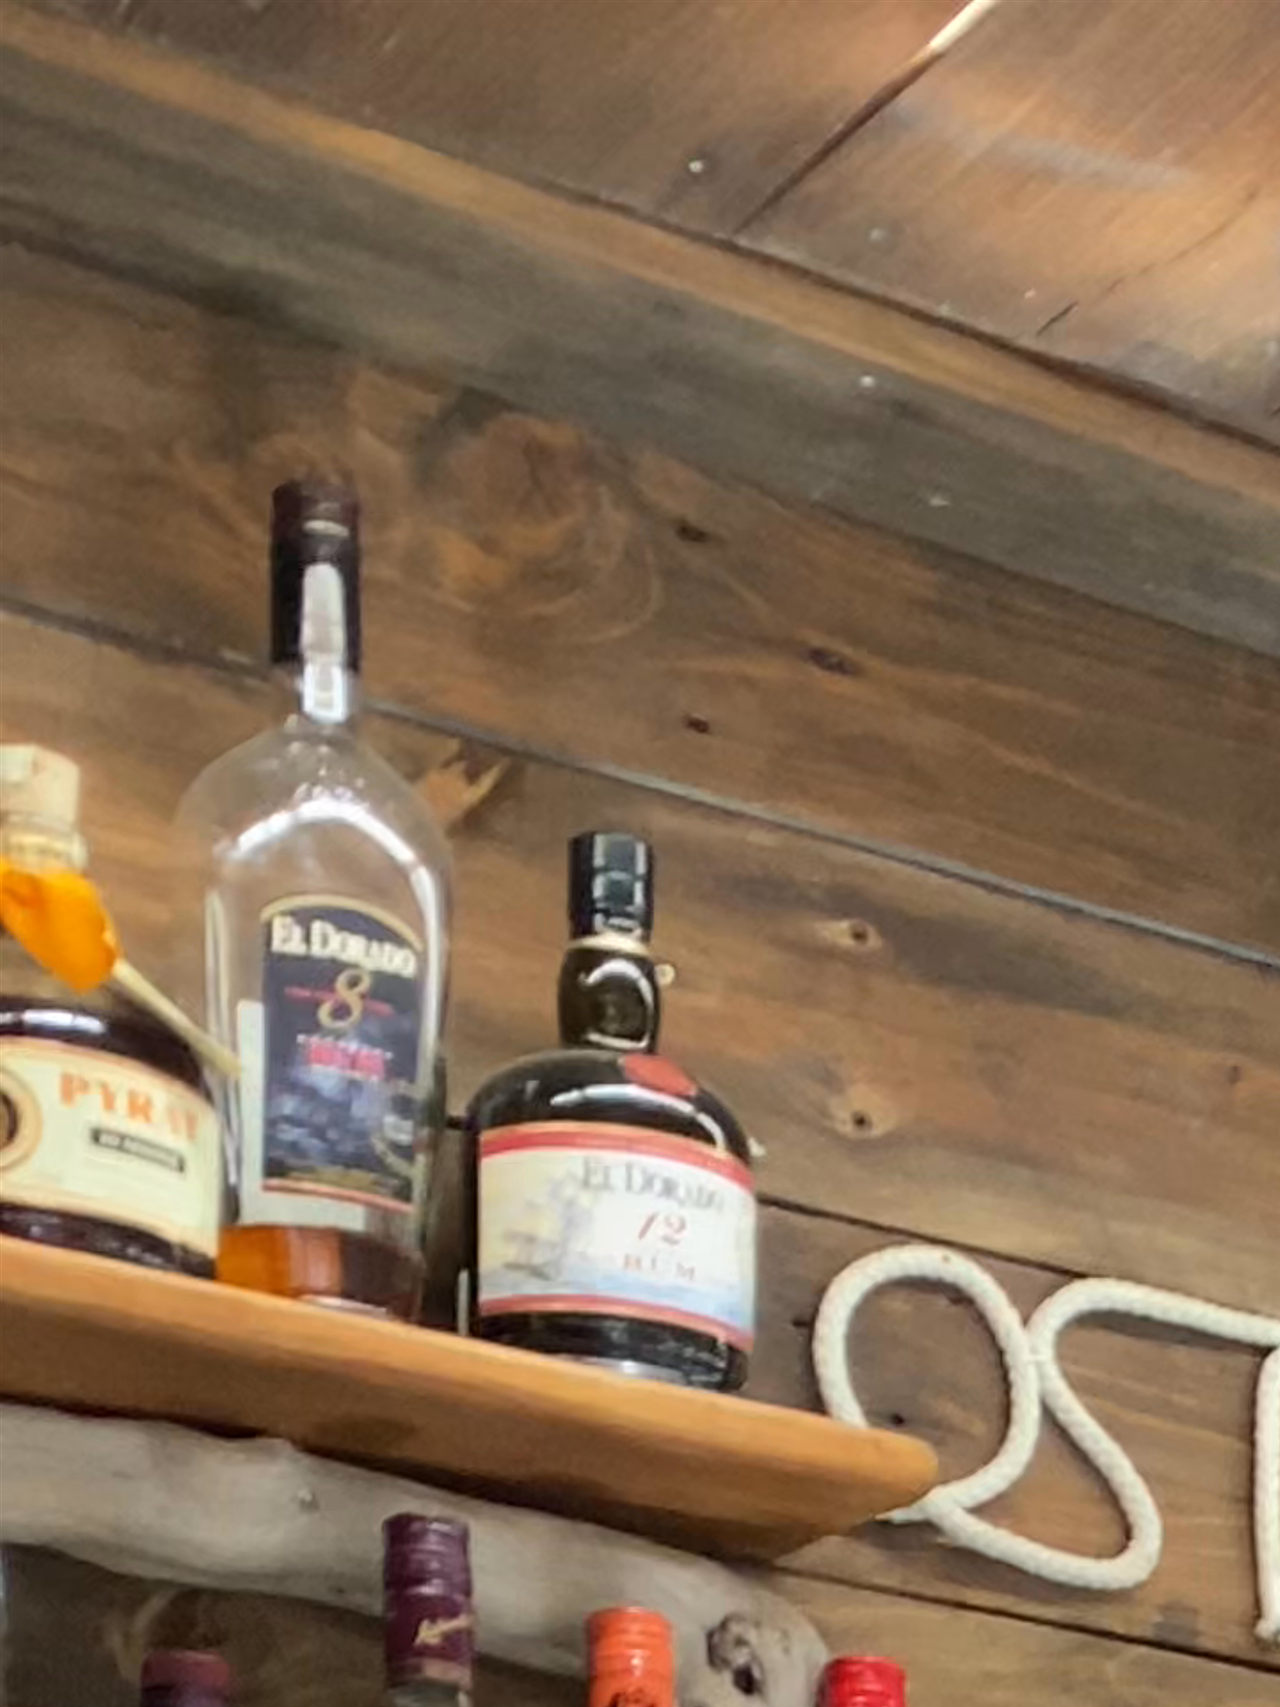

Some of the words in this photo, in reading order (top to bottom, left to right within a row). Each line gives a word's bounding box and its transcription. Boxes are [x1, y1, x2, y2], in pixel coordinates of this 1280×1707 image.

[309, 920, 418, 980] DORADO
[318, 967, 371, 1029] 8
[636, 1212, 688, 1248] 12
